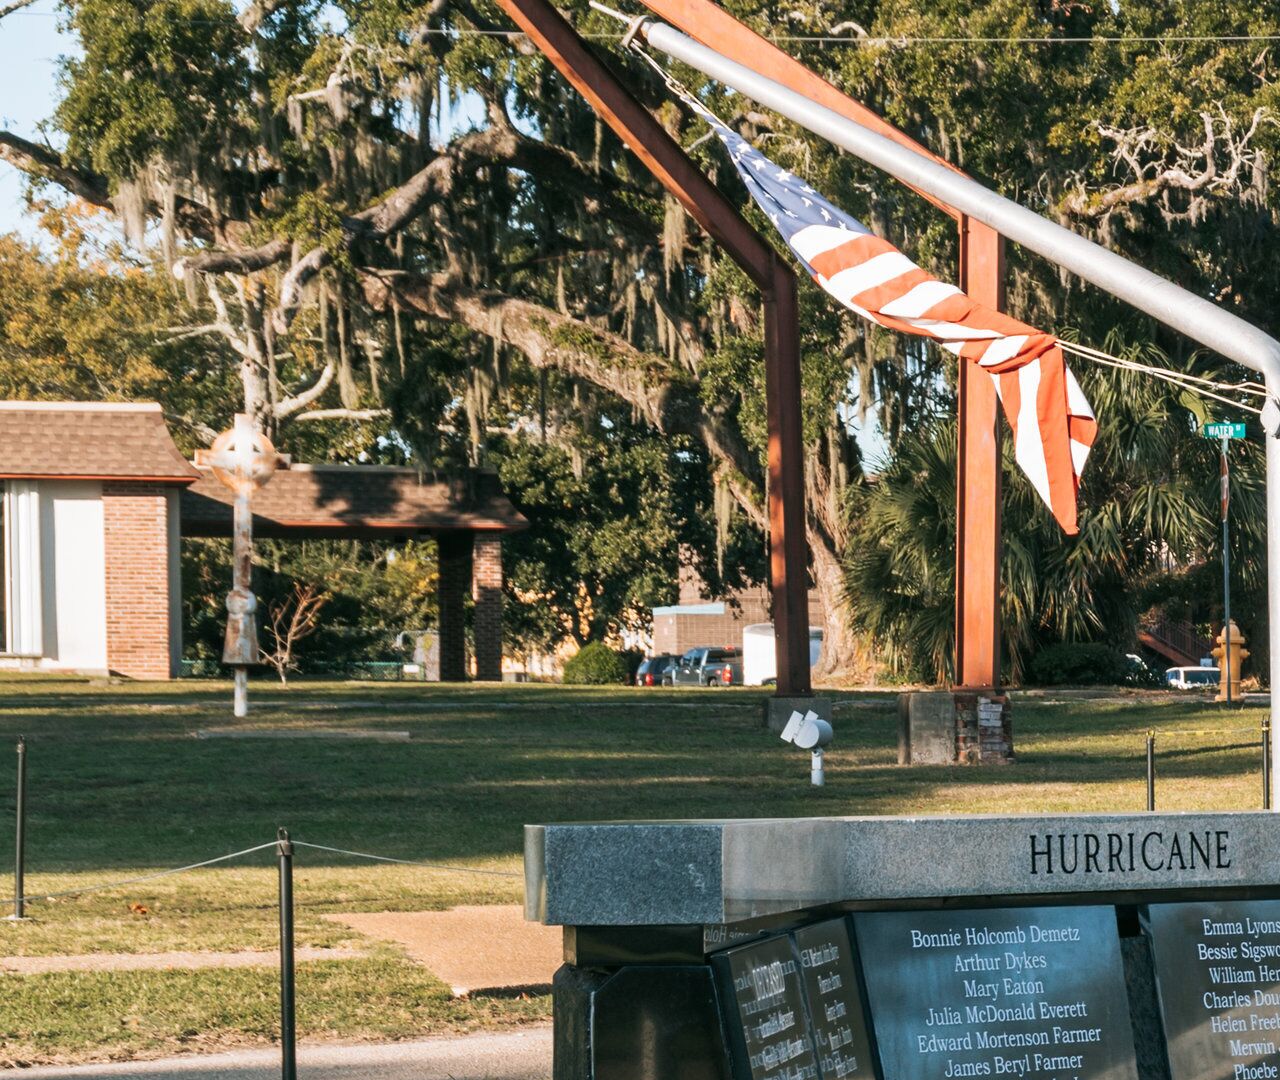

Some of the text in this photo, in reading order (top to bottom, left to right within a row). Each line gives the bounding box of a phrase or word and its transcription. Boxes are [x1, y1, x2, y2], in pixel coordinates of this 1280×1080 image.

[1208, 426, 1233, 436] WATER
[1030, 831, 1231, 874] HURRICANE
[910, 926, 1080, 948] Bonnie Holcomb Demetz
[1202, 919, 1244, 935] Emma
[1197, 942, 1238, 960] Bessie
[1203, 990, 1251, 1009] Charles
[926, 1001, 1088, 1026] Julia McDonald Everett
[945, 1054, 1083, 1077] James Beryl Farmer
